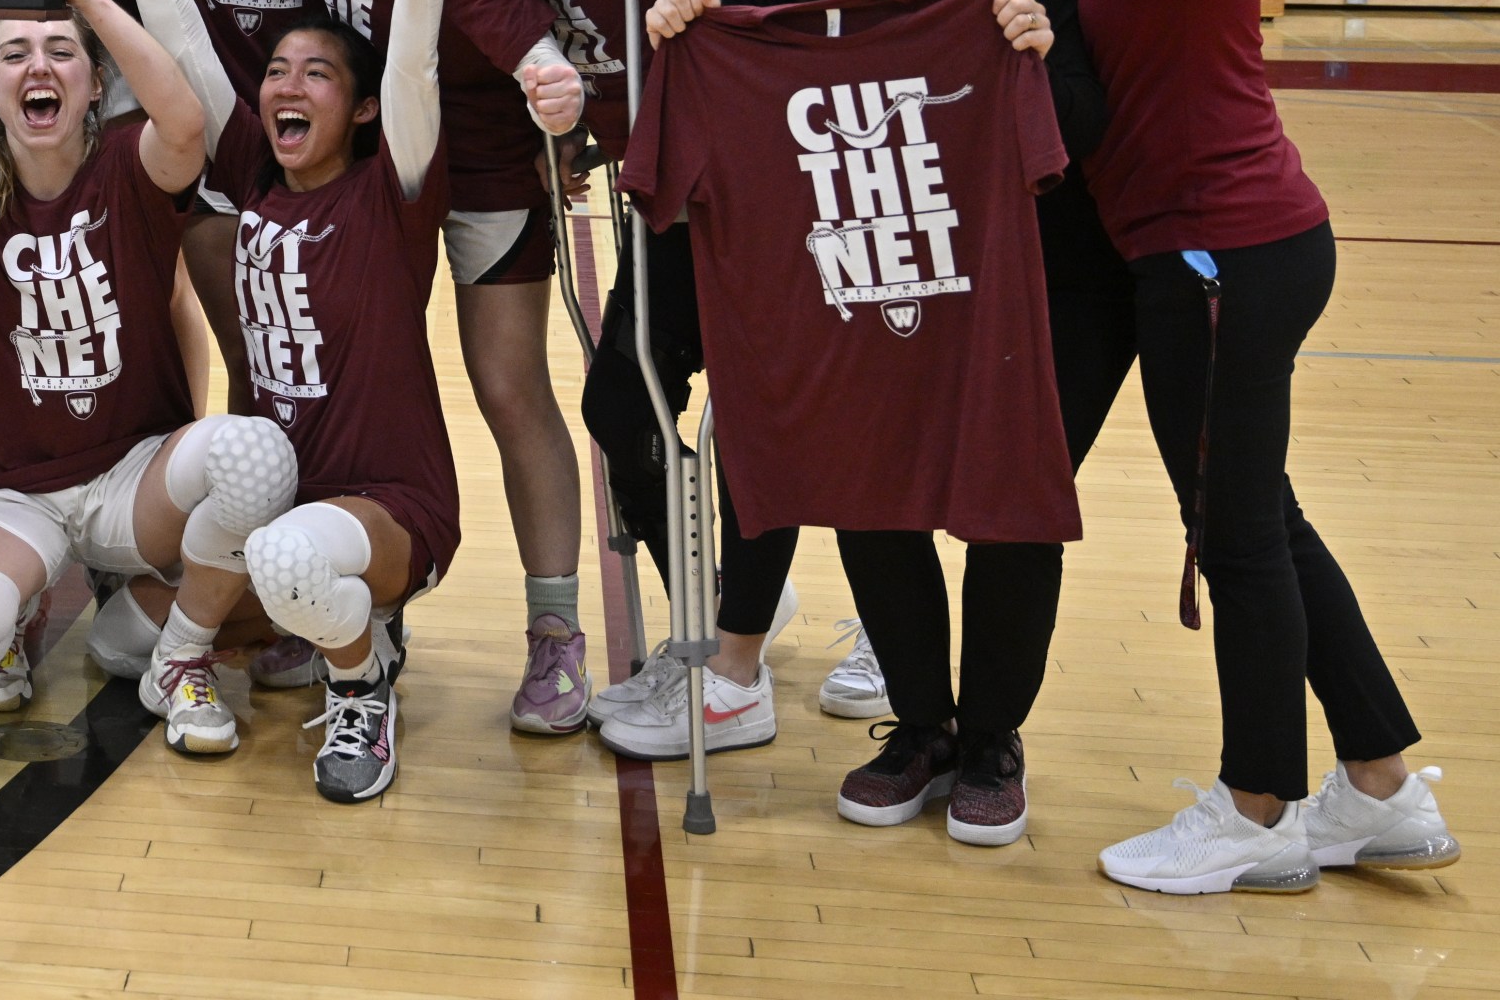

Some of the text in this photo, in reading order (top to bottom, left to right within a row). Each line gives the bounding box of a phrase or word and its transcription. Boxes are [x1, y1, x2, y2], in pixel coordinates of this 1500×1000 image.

[787, 77, 928, 152] CUT
[797, 142, 950, 220] THE
[2, 209, 94, 282] CUT
[235, 211, 309, 273] CUT
[809, 209, 959, 289] NET
[10, 261, 120, 330] THE
[235, 261, 316, 330] THE
[838, 279, 961, 296] WESTMONT
[886, 305, 916, 328] W
[15, 313, 122, 377] NET
[239, 315, 323, 385] NET
[32, 373, 114, 384] WESTMON
[69, 397, 93, 415] W
[274, 401, 294, 422] W
